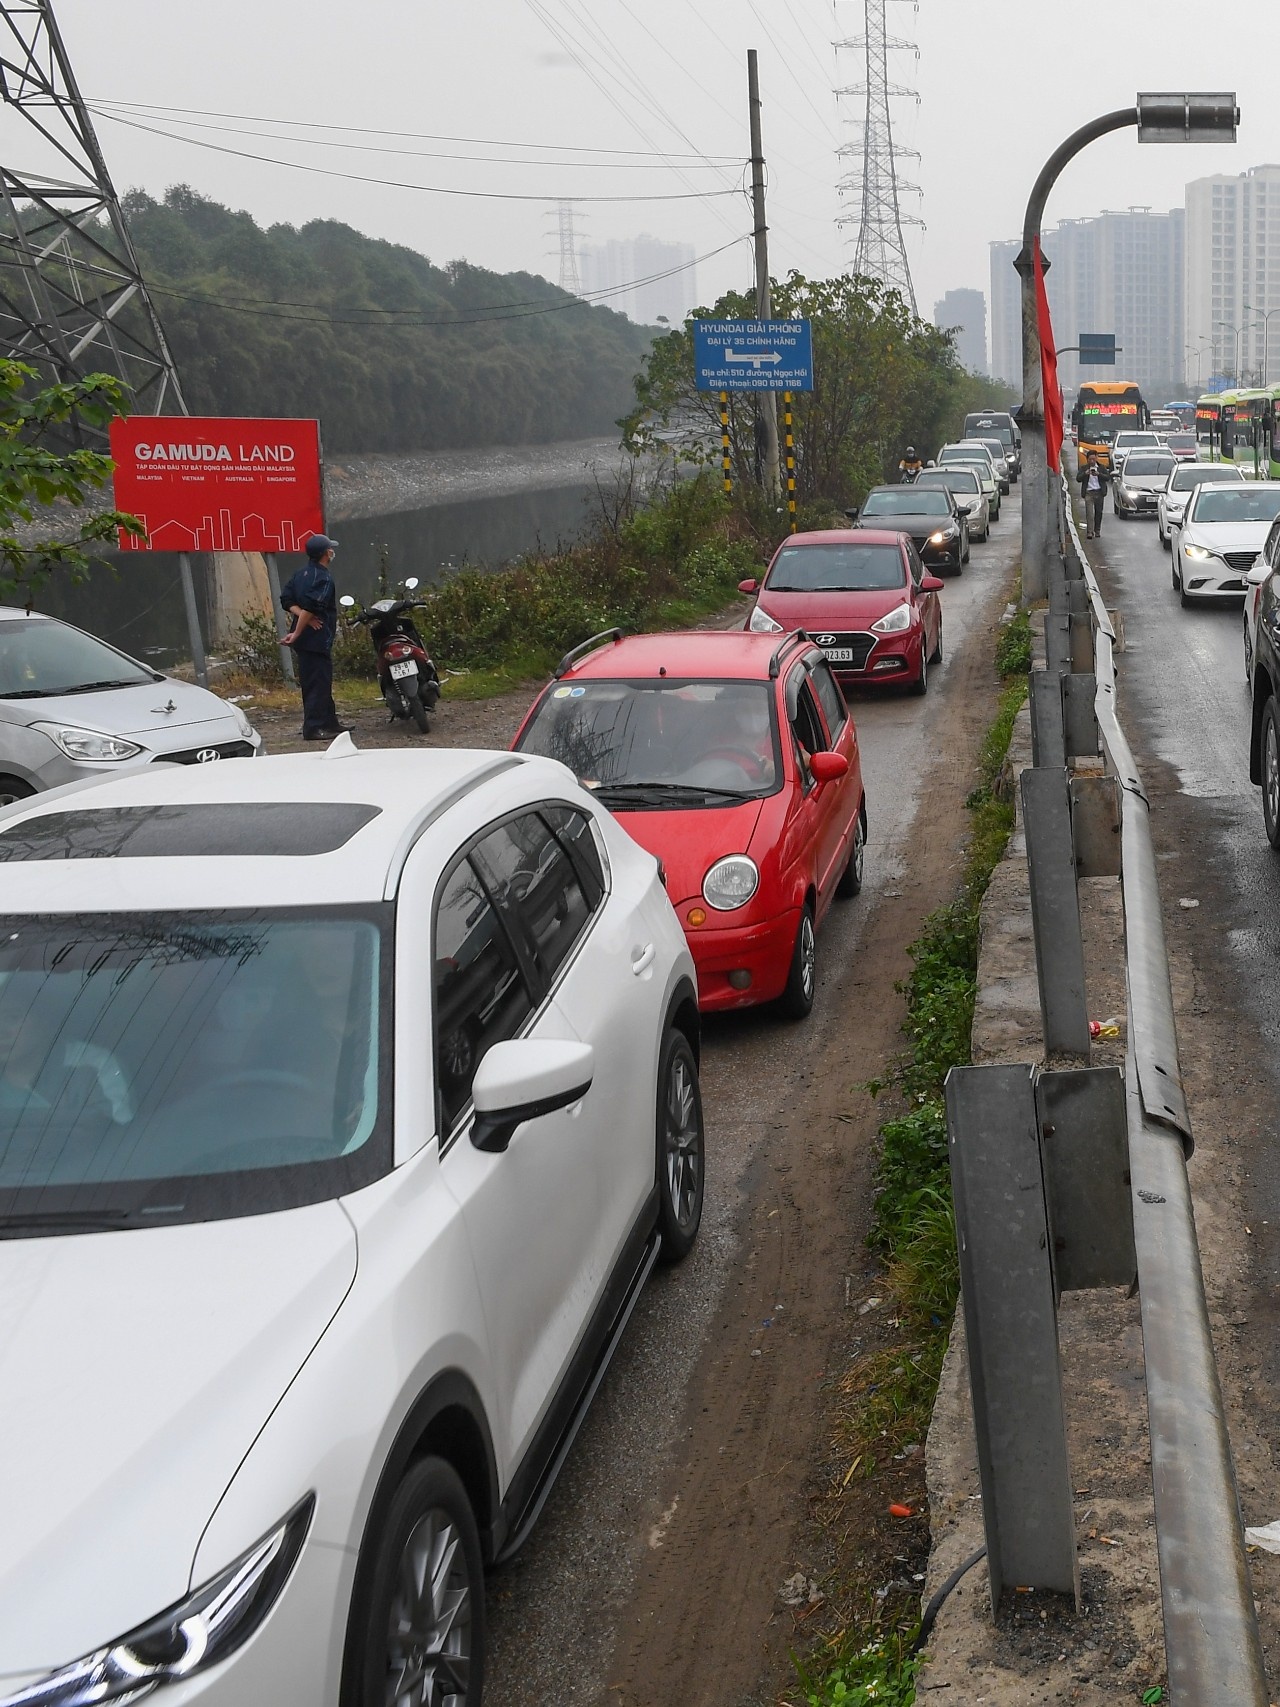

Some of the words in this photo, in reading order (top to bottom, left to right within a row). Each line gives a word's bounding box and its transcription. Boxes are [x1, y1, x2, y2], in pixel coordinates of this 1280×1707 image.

[700, 324, 744, 333] HYUNDAI
[135, 443, 232, 462] GAMUDA
[239, 445, 295, 462] LAND
